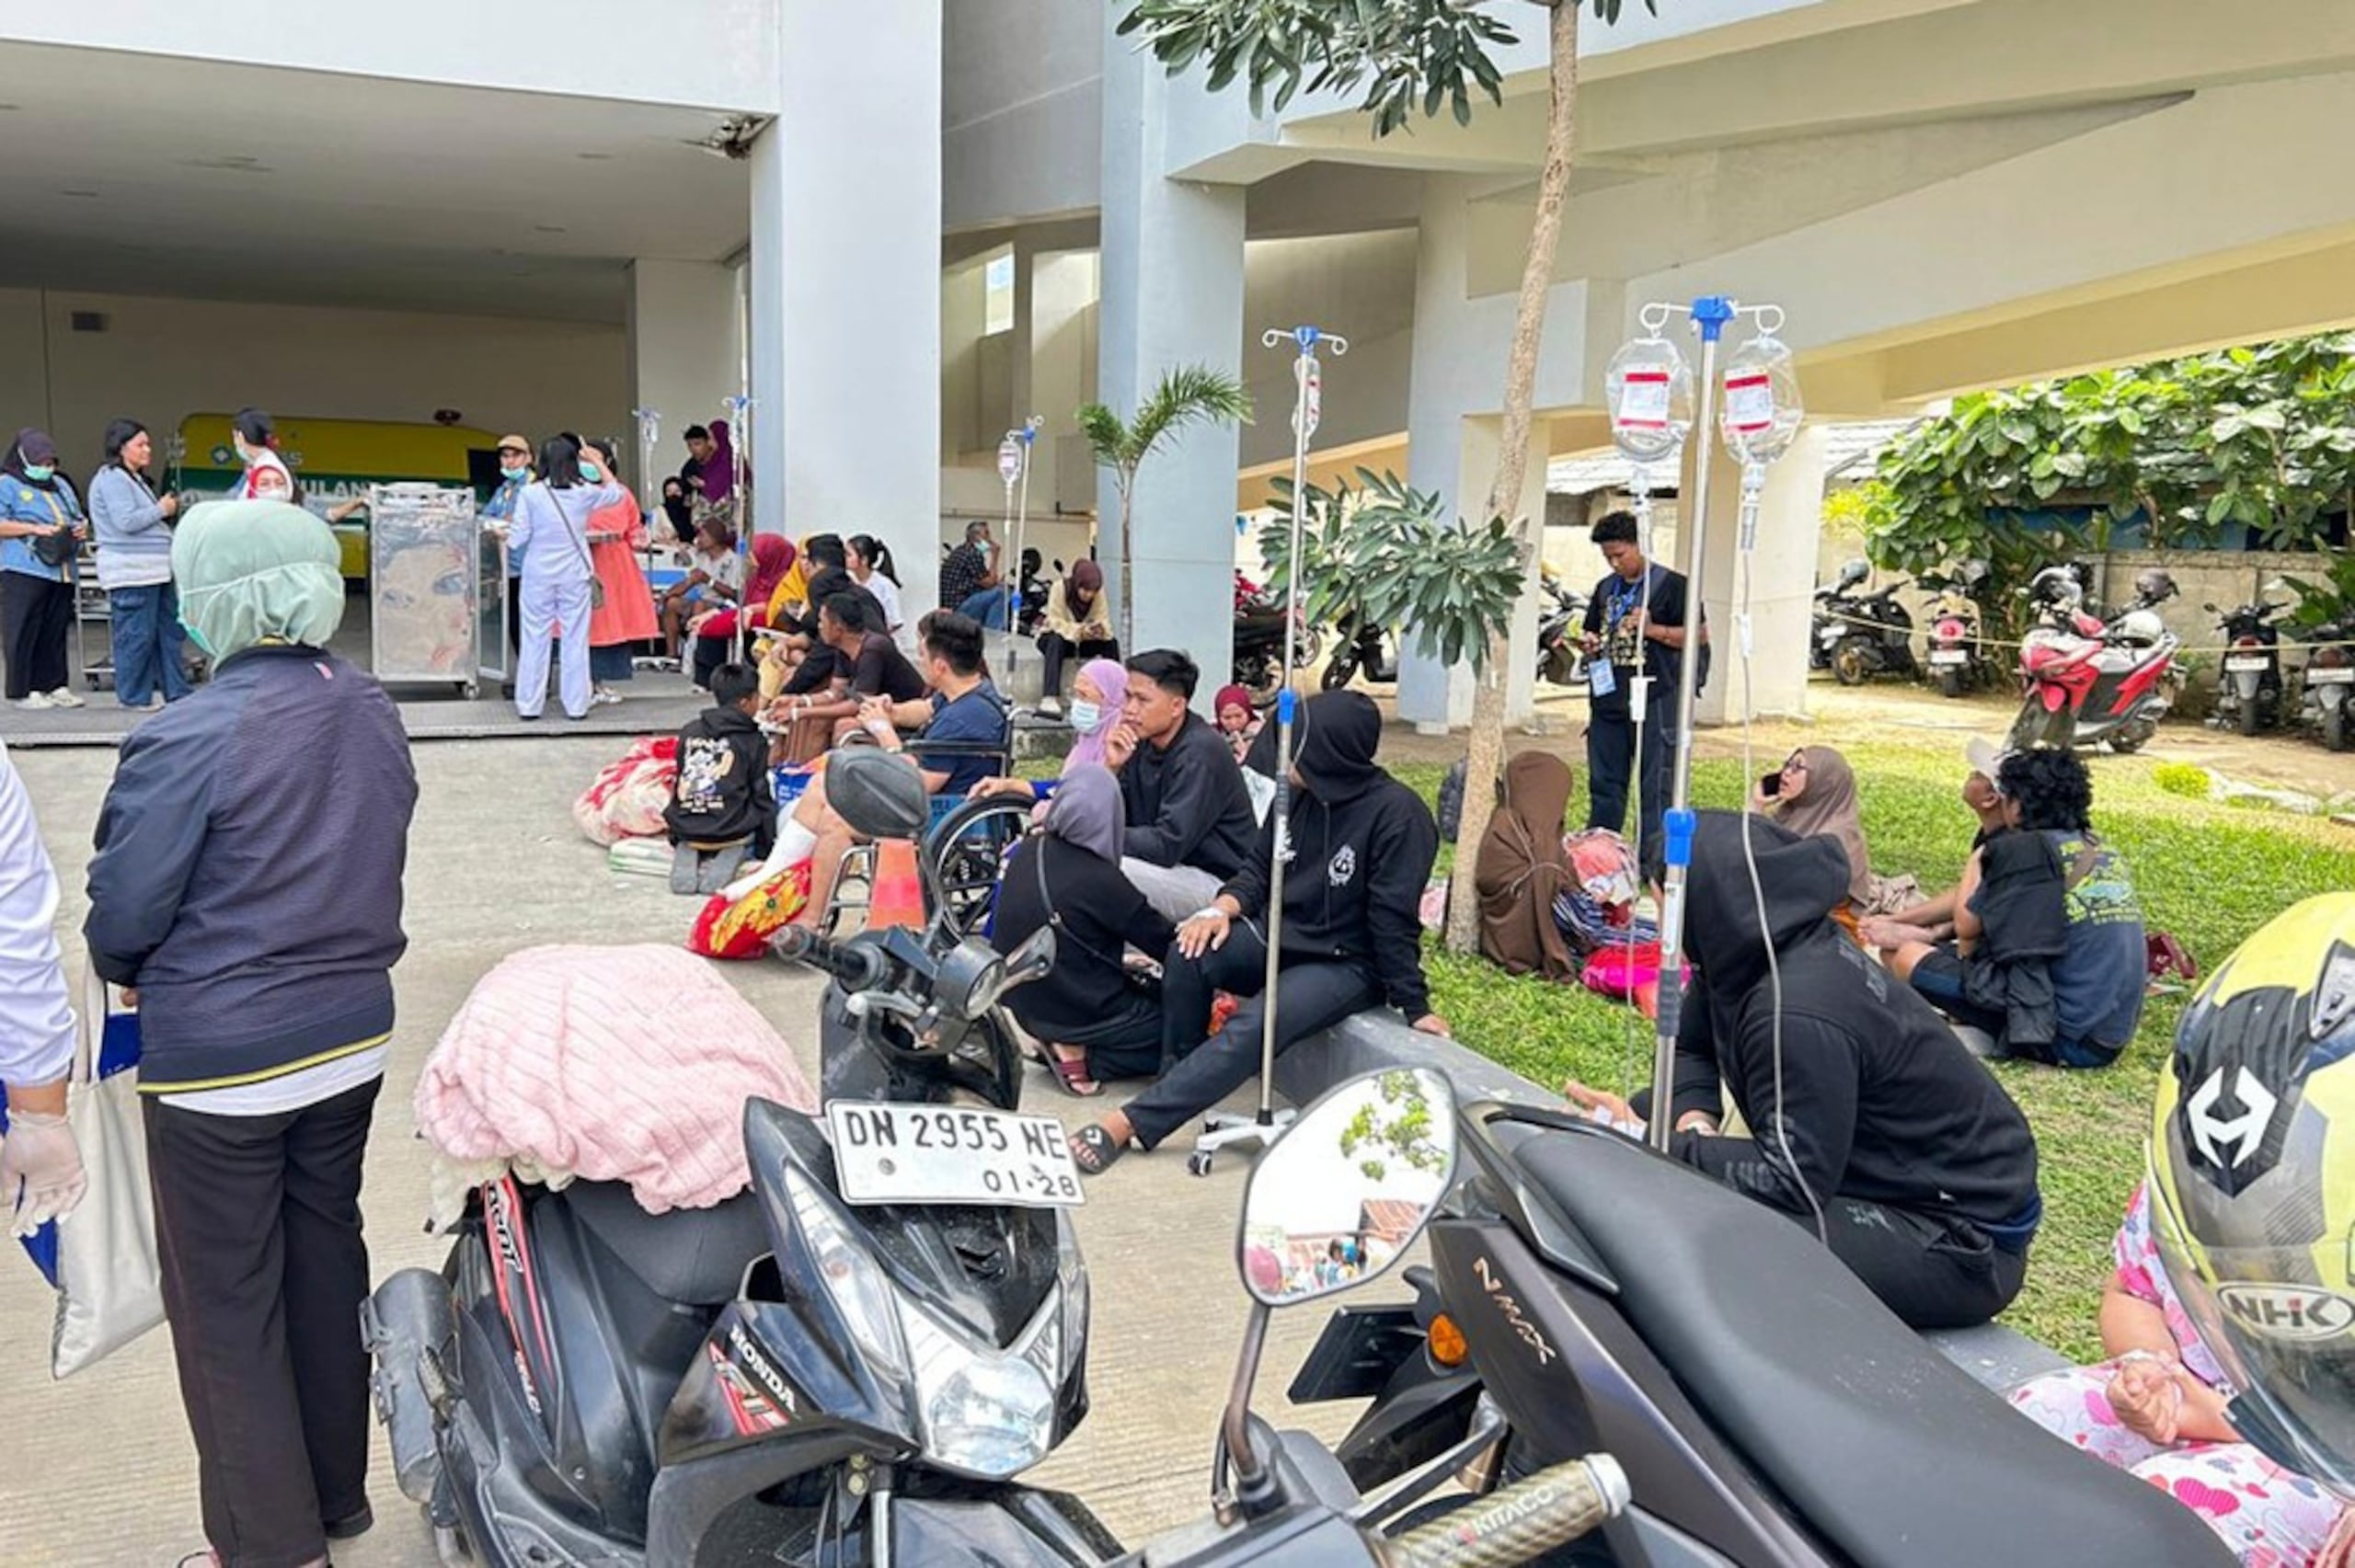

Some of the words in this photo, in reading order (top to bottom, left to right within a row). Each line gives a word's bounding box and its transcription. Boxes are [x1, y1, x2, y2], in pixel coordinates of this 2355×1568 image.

[844, 1110, 897, 1147] DN
[910, 1113, 1008, 1151] 2955
[1020, 1122, 1067, 1160] NE
[1473, 1256, 1557, 1366] NMAX
[2227, 1292, 2338, 1327] NHK
[729, 1322, 797, 1413] HONDA
[1473, 1483, 1555, 1536] KITACO
